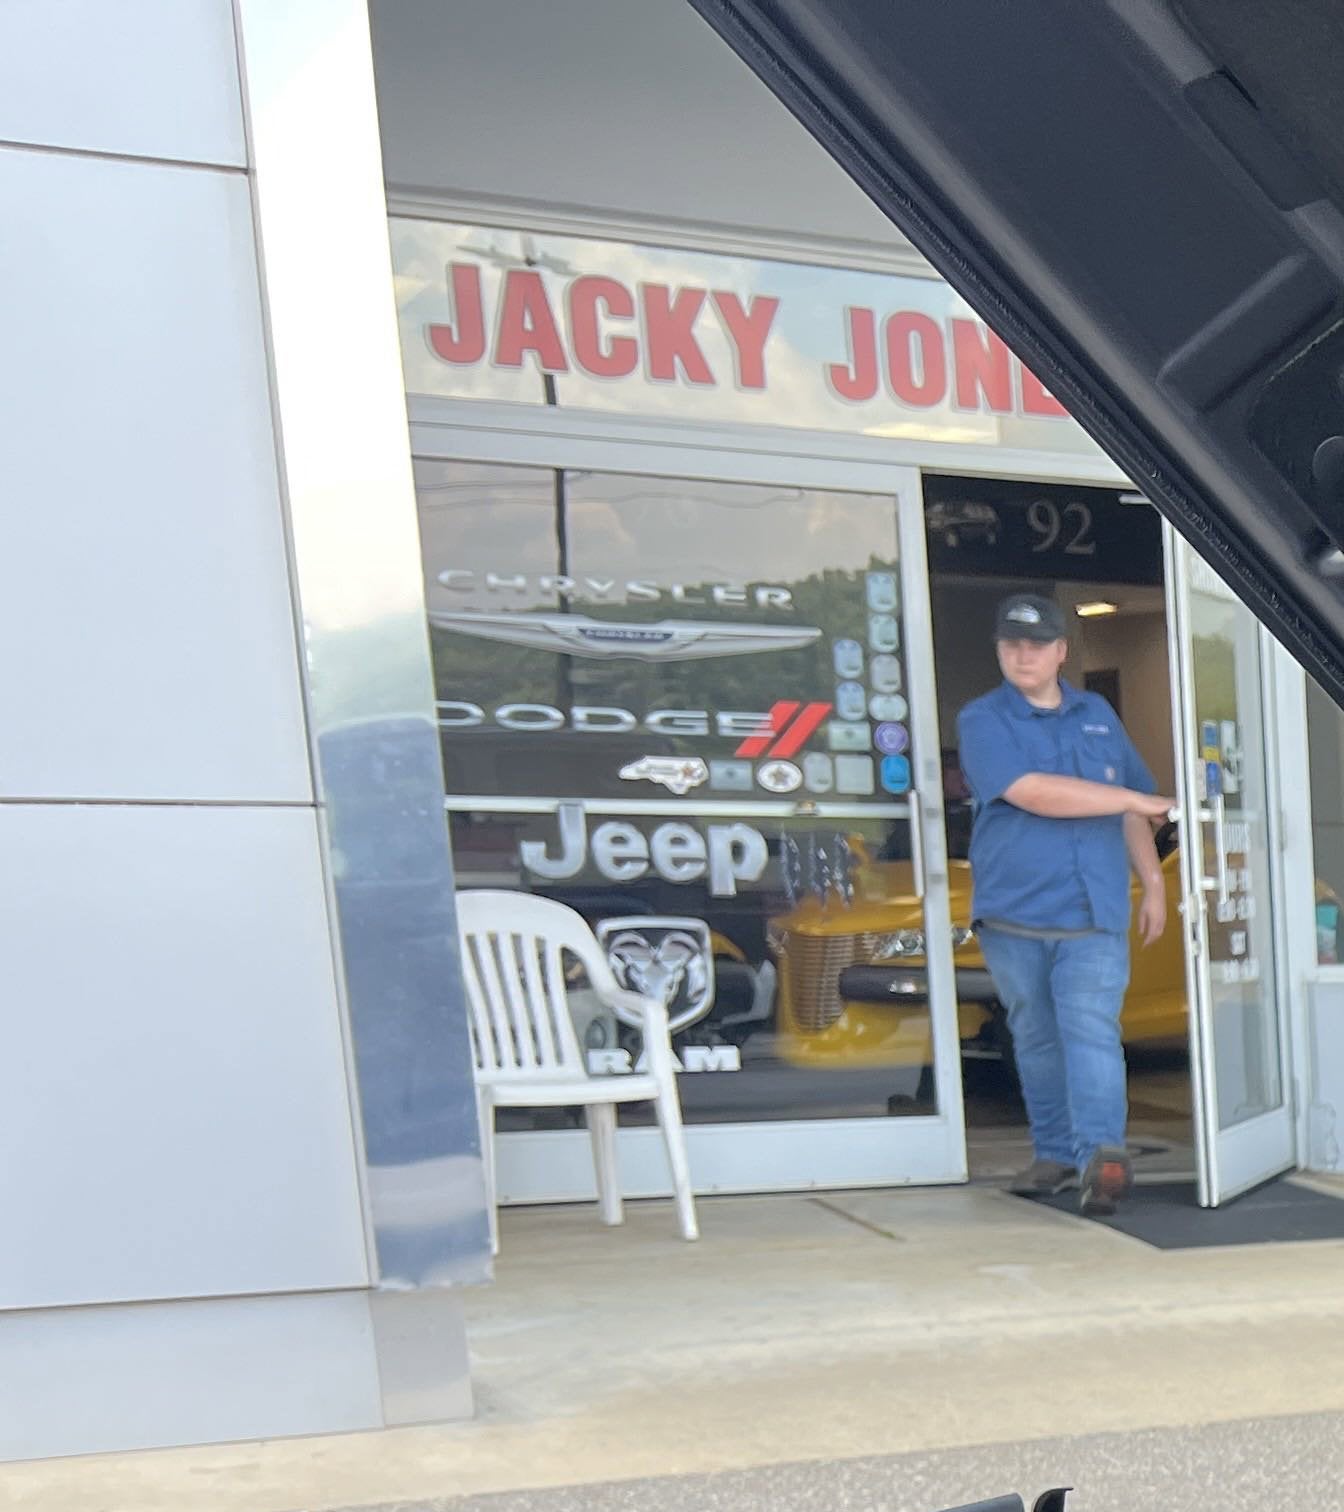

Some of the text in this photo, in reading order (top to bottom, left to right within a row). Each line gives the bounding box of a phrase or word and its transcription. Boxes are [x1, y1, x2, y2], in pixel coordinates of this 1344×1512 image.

[424, 262, 781, 391] JACKY
[1026, 500, 1096, 556] 92
[437, 569, 797, 611] CHRYSLER
[435, 700, 776, 737] DODGE
[520, 804, 769, 898] Jeep
